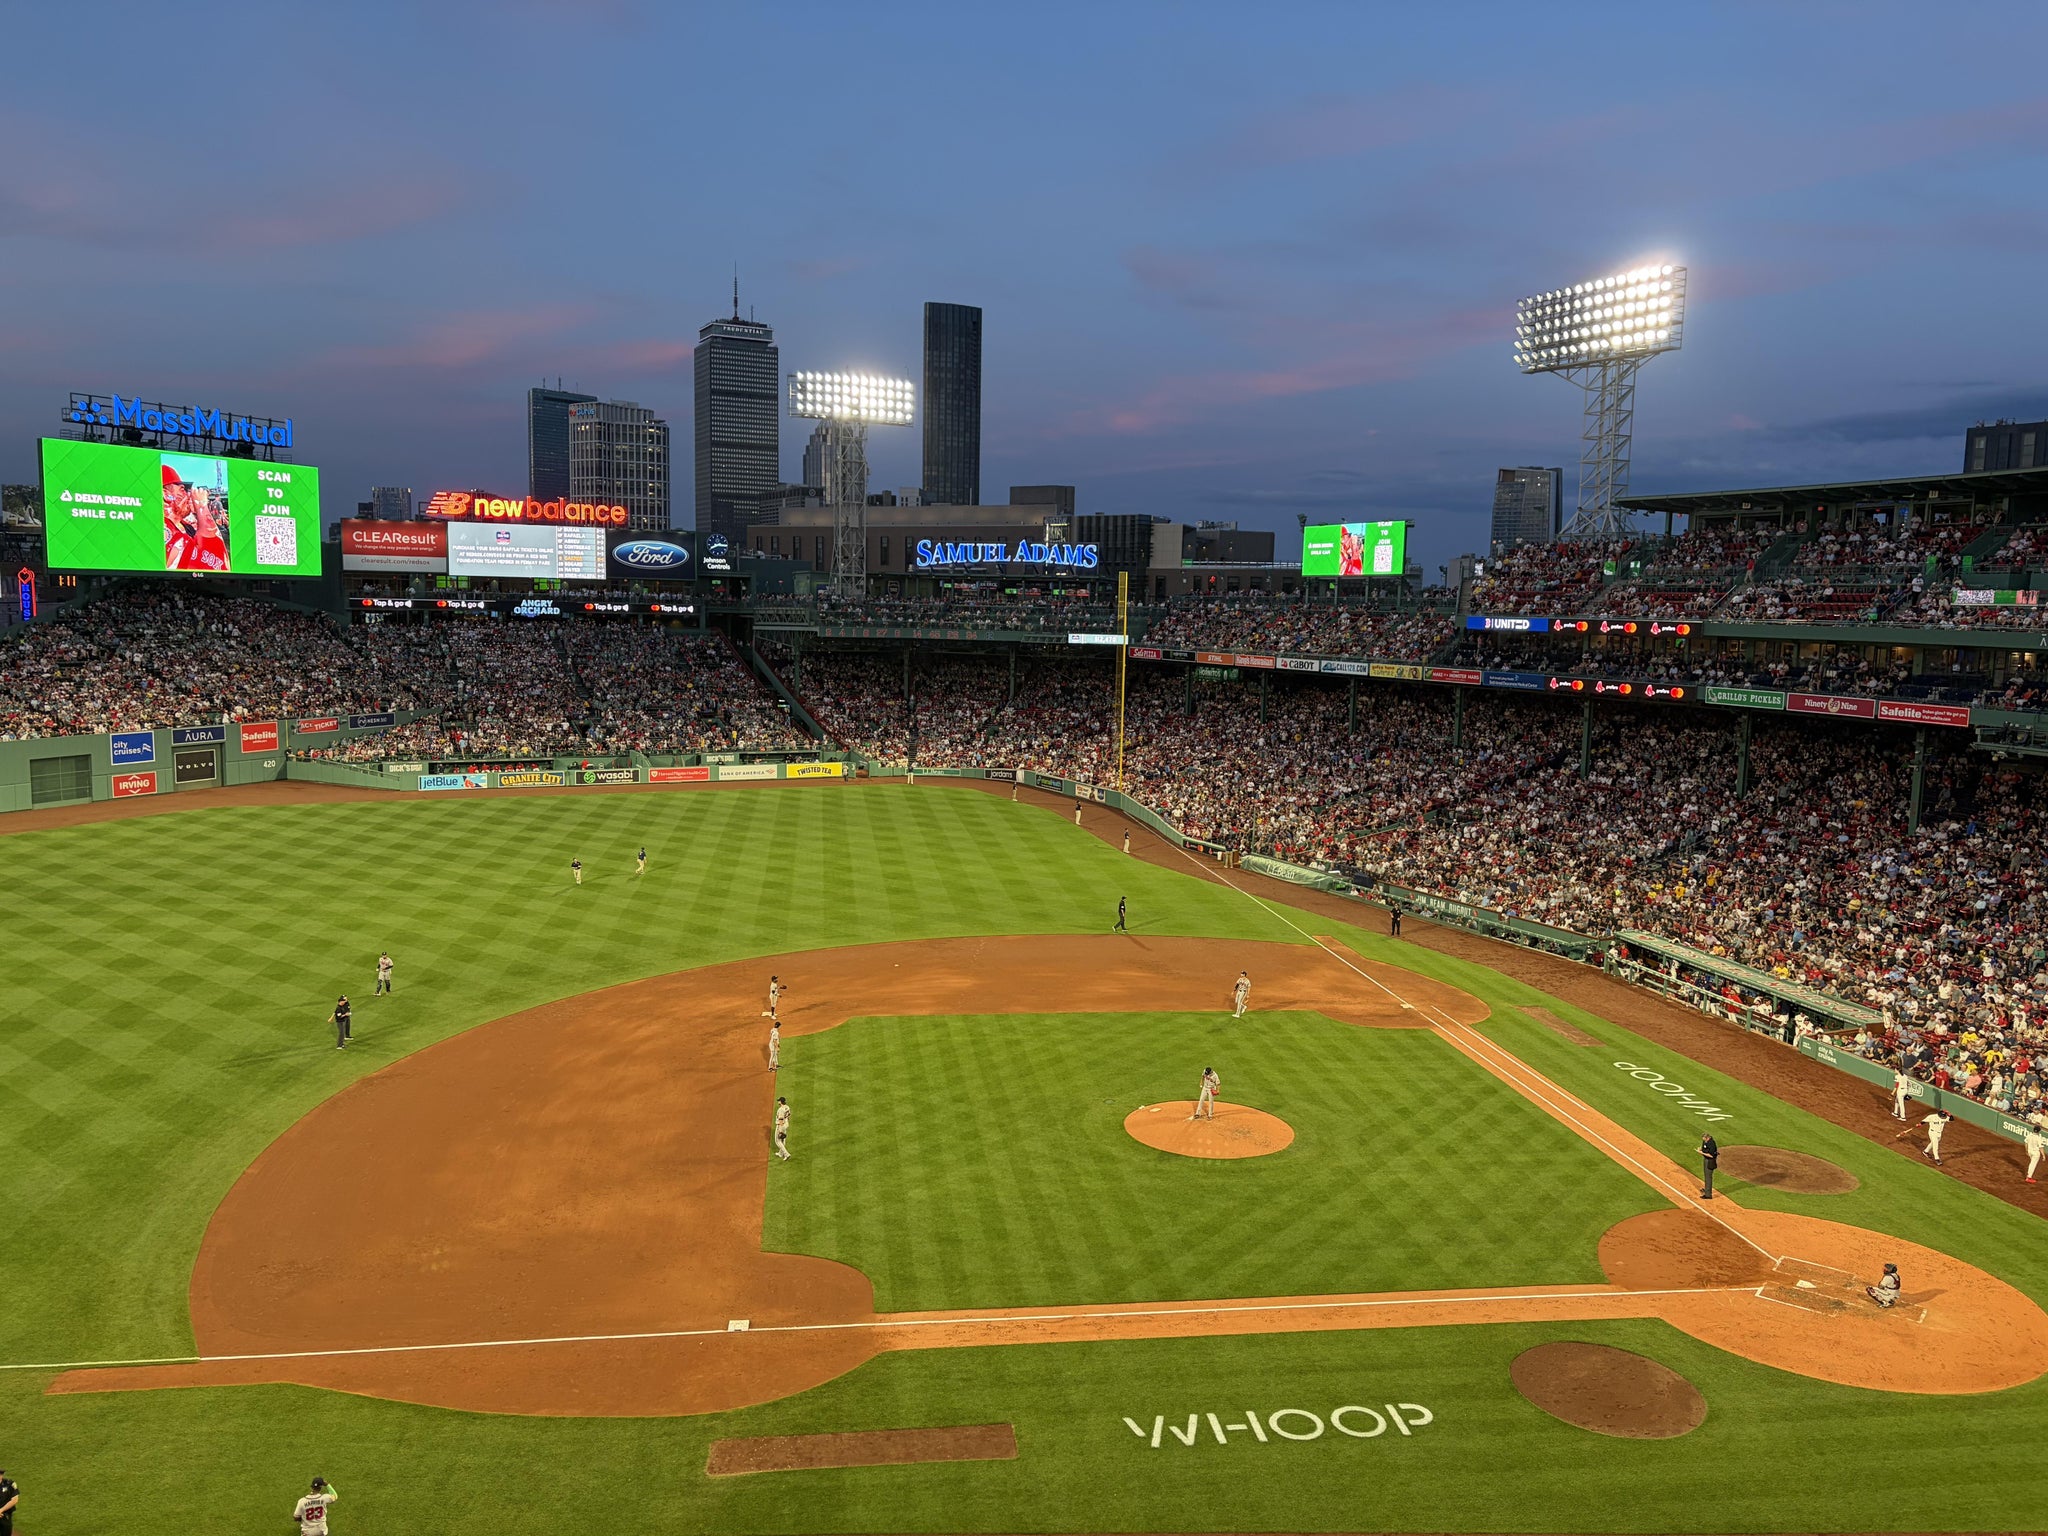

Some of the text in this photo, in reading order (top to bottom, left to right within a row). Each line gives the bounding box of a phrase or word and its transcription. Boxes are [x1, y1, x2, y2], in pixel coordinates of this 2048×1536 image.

[112, 393, 293, 447] MassMutual
[257, 470, 291, 483] SCAN
[266, 488, 284, 499] TO
[74, 493, 141, 507] DELTA DENTAL
[72, 508, 134, 521] SMILE CAM
[262, 504, 290, 516] JOIN
[474, 496, 626, 524] new balance
[352, 530, 436, 544] CLEAResult
[628, 544, 674, 564] Ford
[916, 538, 1098, 568] SAMUEL ADAMS
[22, 584, 31, 620] HOUS
[373, 600, 387, 608] Tap
[660, 604, 672, 612] Tap
[1494, 618, 1530, 630] UNITED
[1718, 692, 1782, 704] GRILLO'S PICKLES
[1804, 699, 1828, 709] Ninety
[1840, 702, 1858, 710] Nine
[1881, 706, 1922, 718] Safelite
[314, 720, 338, 730] TICKET
[242, 731, 277, 741] Safelite
[114, 741, 128, 749] city
[114, 747, 141, 756] cruises
[178, 762, 214, 770] VOLVO
[264, 760, 276, 768] 420
[389, 764, 411, 772] DICK'S
[597, 770, 633, 780] wasabi
[797, 766, 832, 776] TWISTED TEA
[120, 779, 150, 790] IRVING
[424, 776, 458, 789] jetBlue
[501, 775, 540, 786] GRANITE
[542, 773, 562, 784] CITY
[1613, 1062, 1734, 1122] WHOOP
[1122, 1403, 1434, 1448] WHOOP
[306, 1506, 324, 1520] 23
